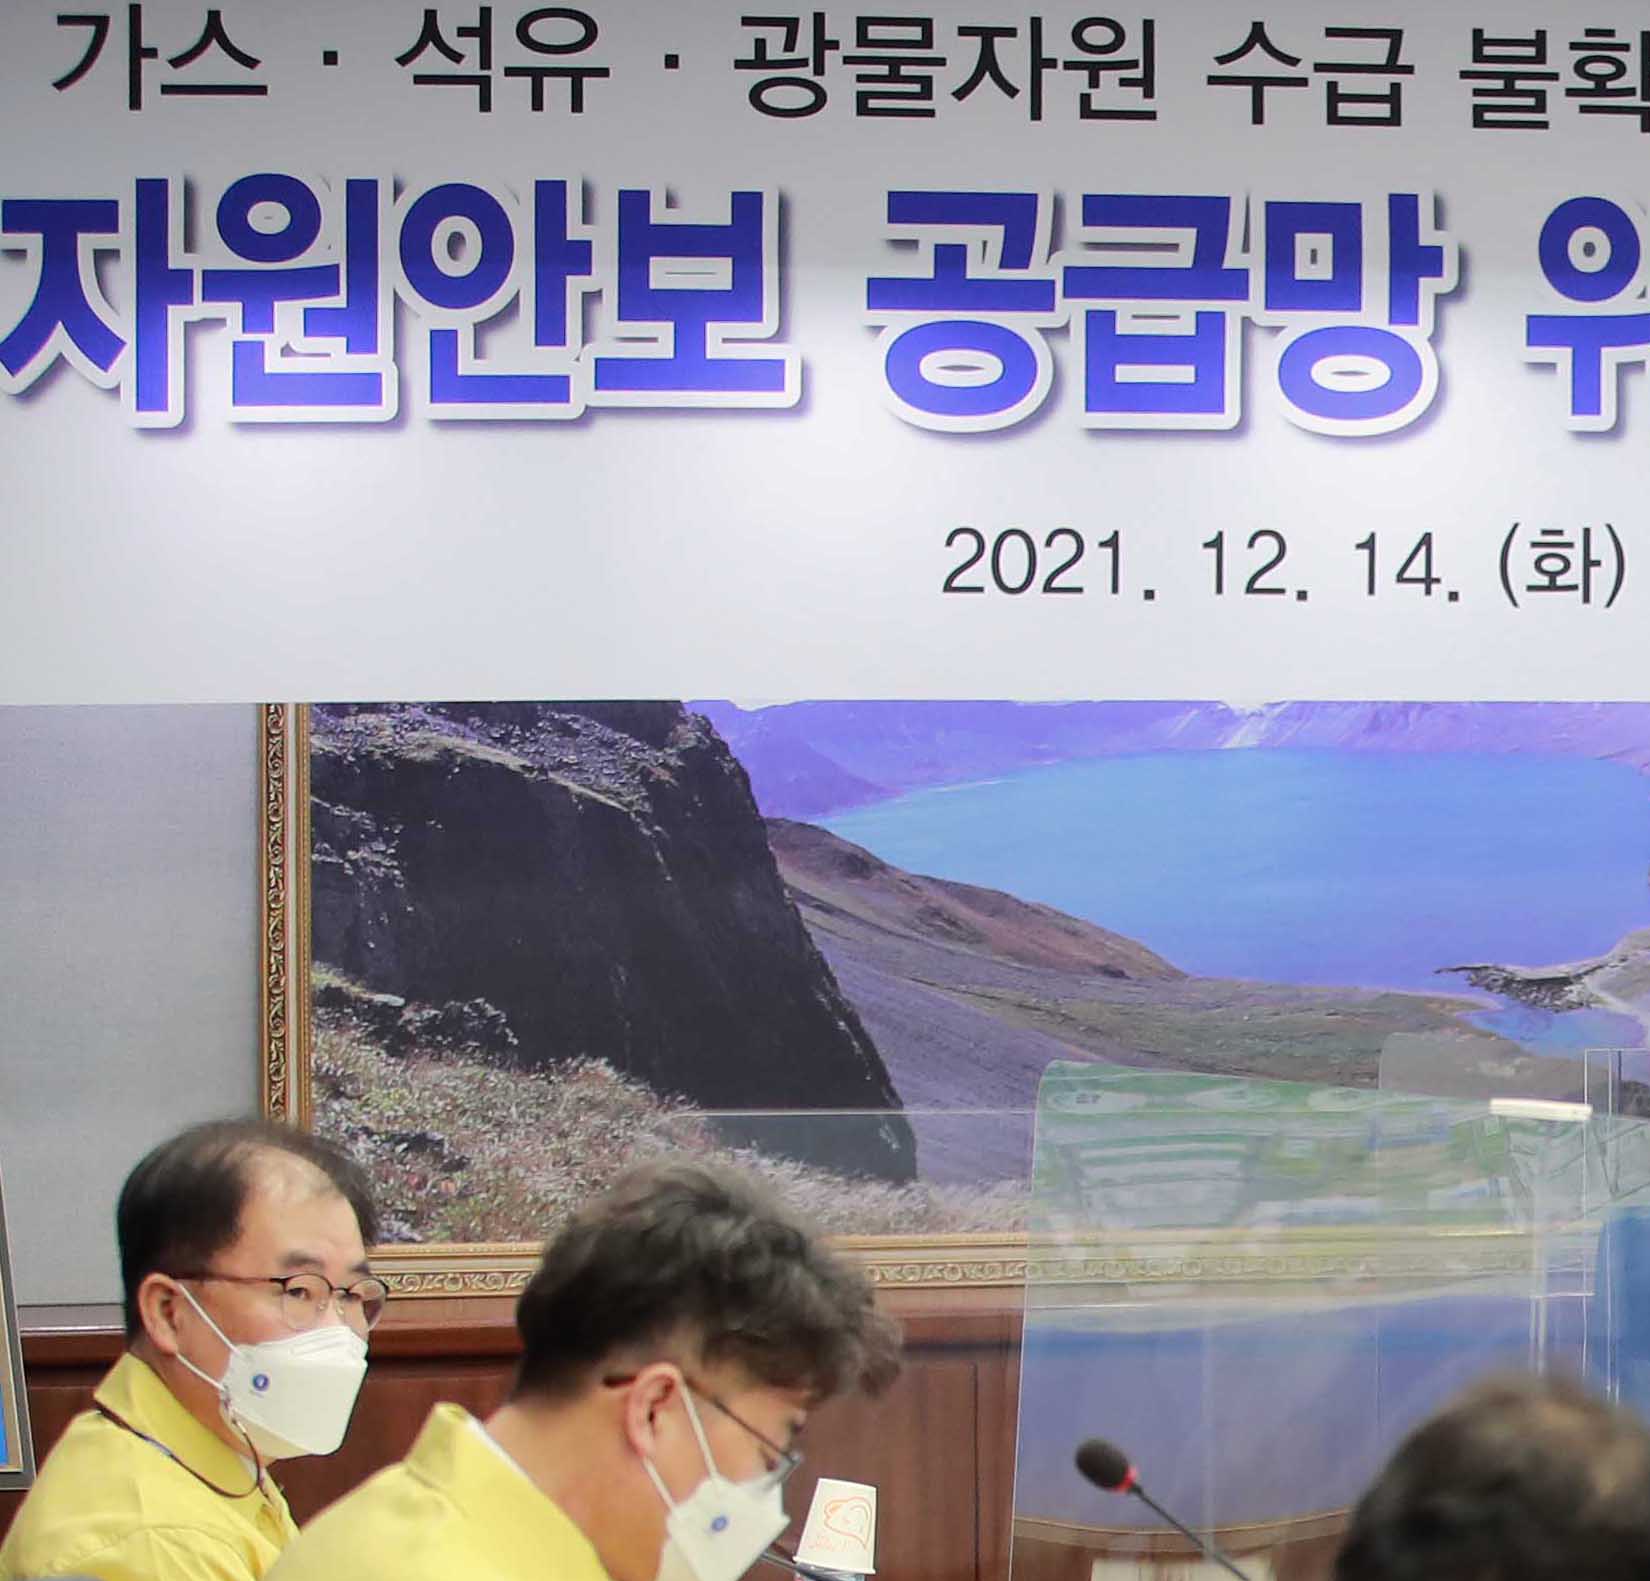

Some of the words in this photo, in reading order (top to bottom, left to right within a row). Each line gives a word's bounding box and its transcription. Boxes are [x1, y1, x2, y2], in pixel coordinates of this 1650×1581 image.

[51, 2, 269, 111] 가스
[393, 5, 611, 114] 석유
[732, 10, 1158, 121] 광물자원
[1206, 20, 1416, 127] 수급
[0, 172, 786, 413] 자원안보
[865, 190, 1444, 420] 공급망
[941, 526, 1156, 601] 2021.
[1202, 528, 1309, 601] 12.
[1354, 531, 1460, 602] 14.
[1498, 521, 1626, 608] (화)
